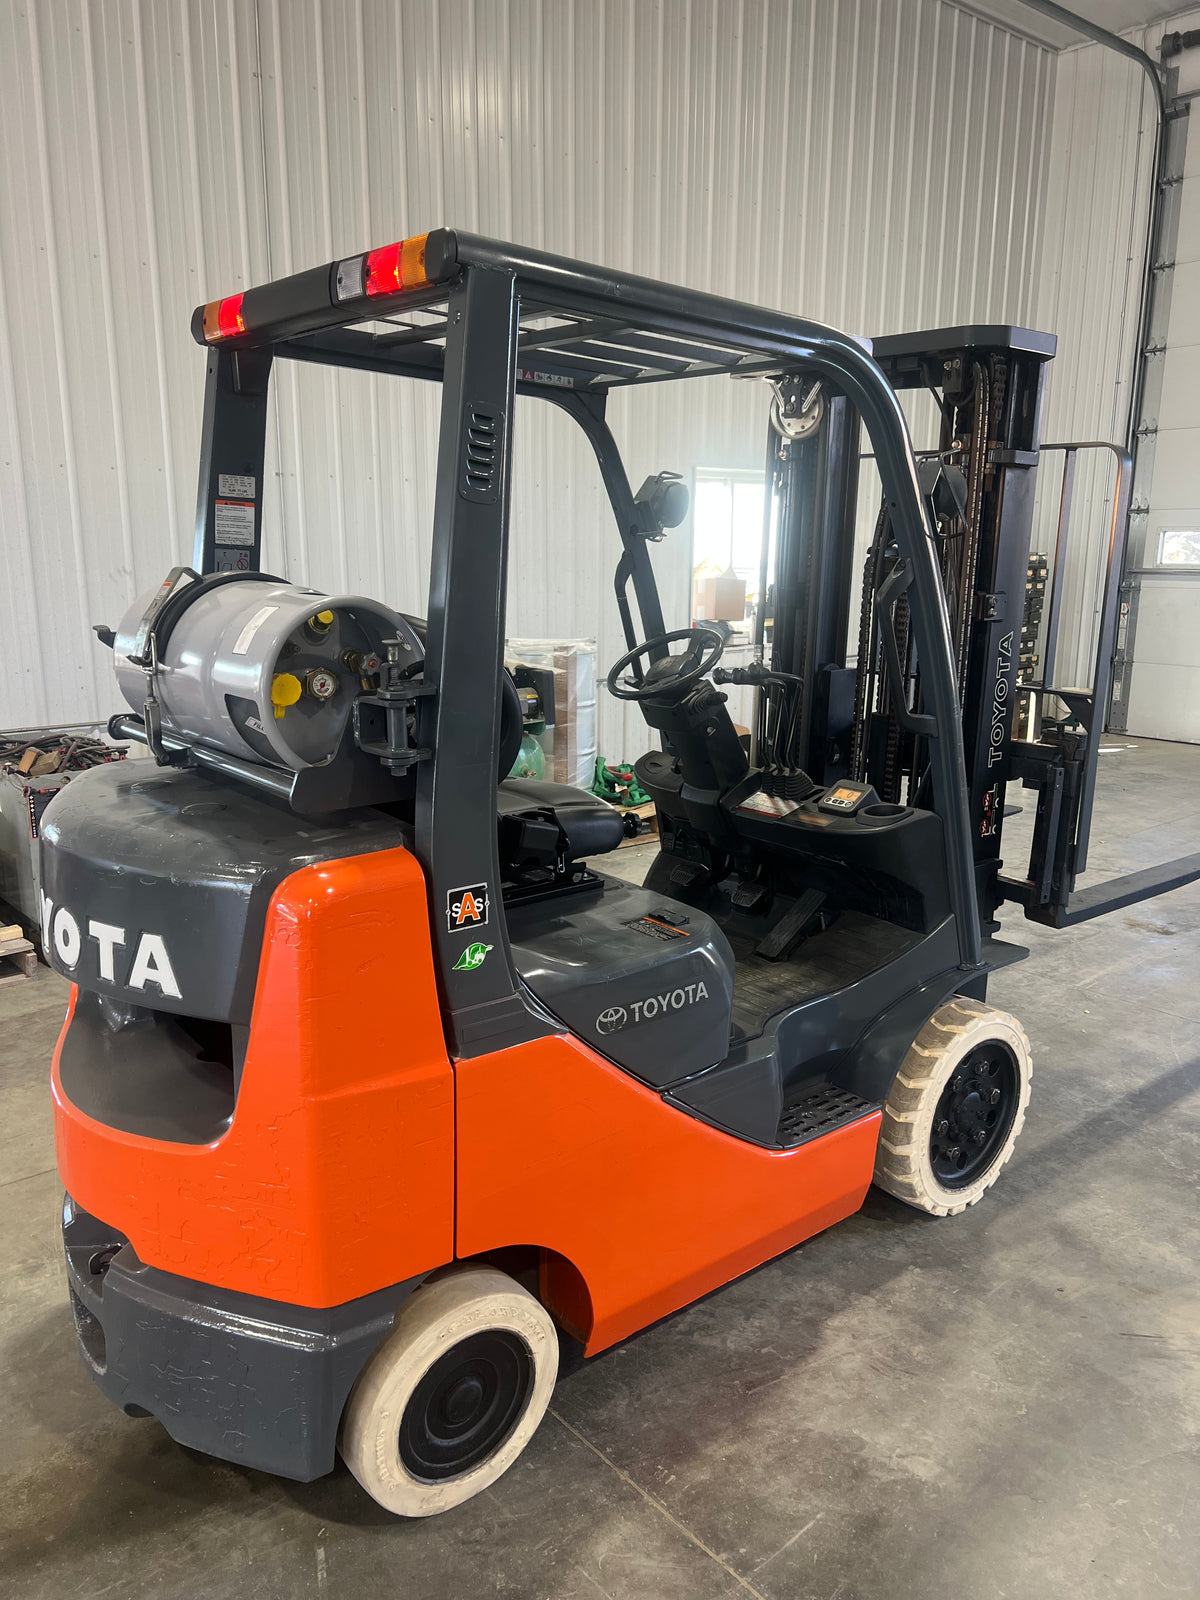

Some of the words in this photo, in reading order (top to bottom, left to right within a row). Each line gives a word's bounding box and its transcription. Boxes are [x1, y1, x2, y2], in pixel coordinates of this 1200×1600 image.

[987, 631, 1014, 768] TOYOTA
[451, 892, 484, 925] SAS
[630, 981, 709, 1022] TOYOTA
